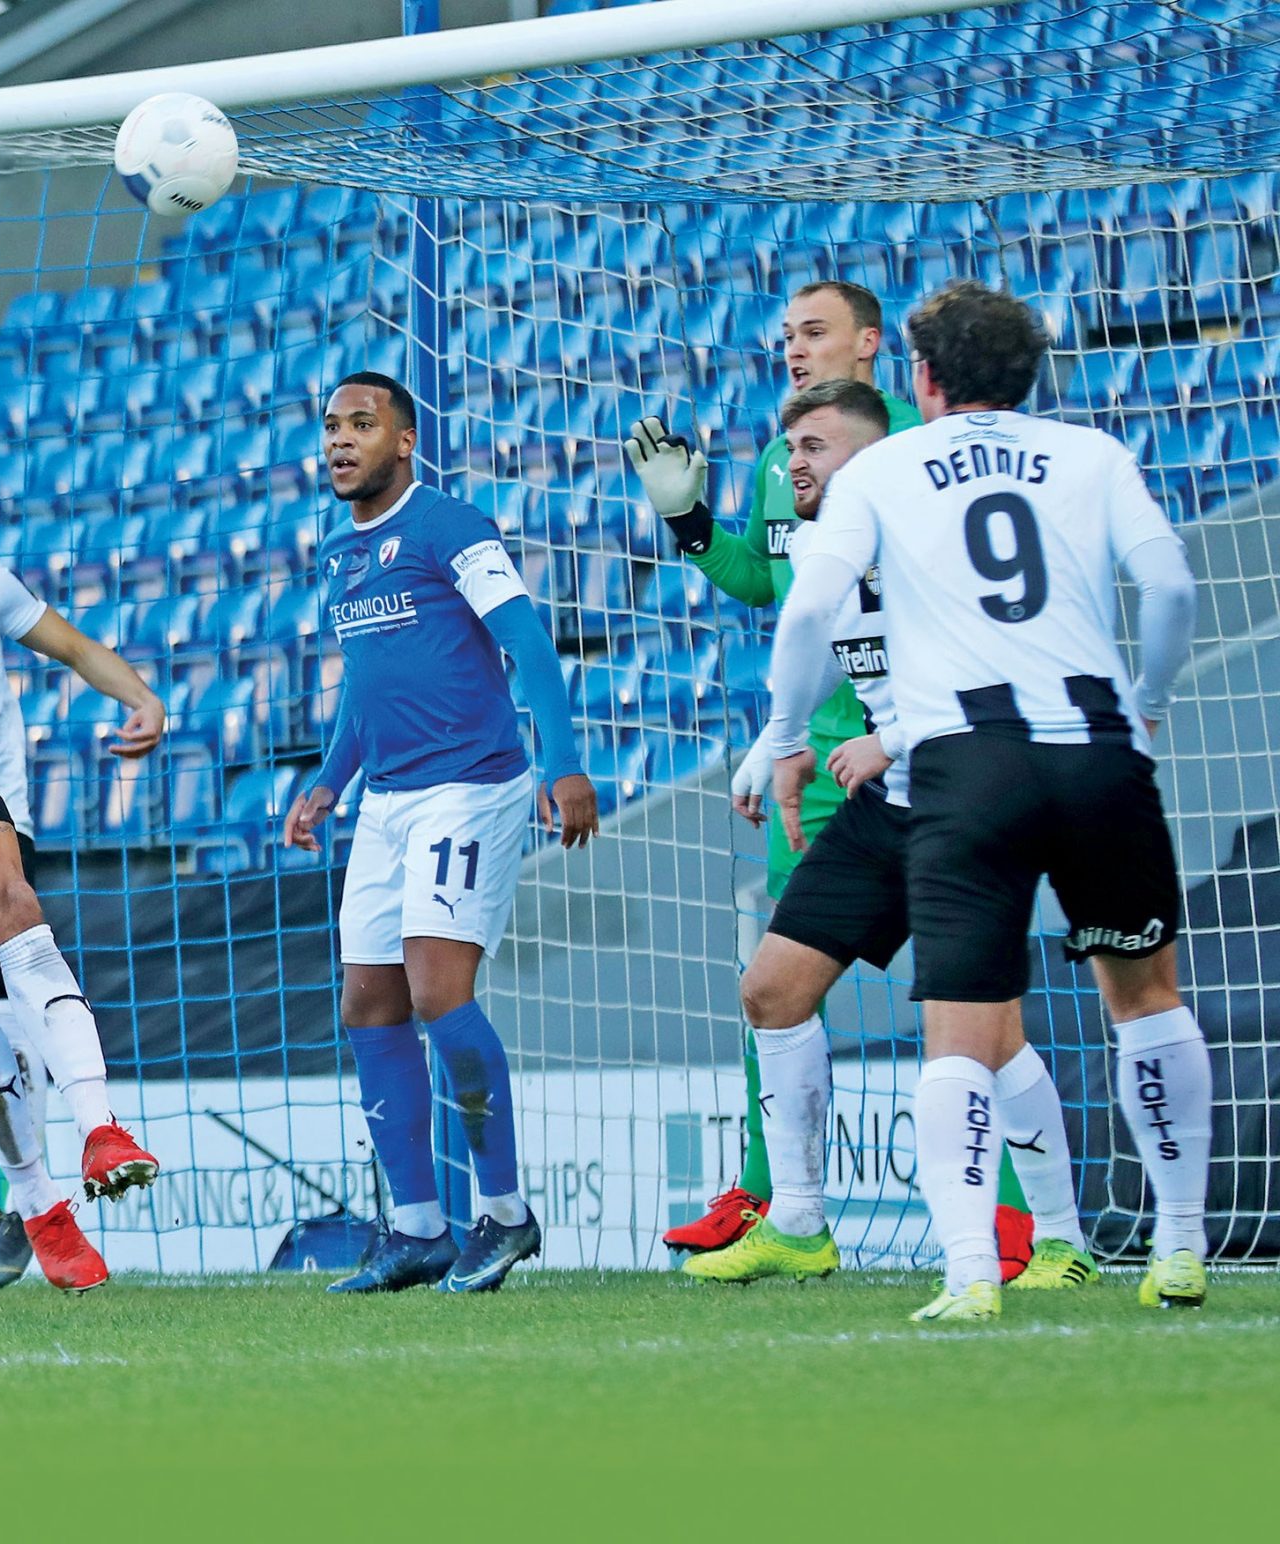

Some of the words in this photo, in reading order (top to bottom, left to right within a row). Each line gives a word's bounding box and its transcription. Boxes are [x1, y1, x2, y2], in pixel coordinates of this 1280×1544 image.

[169, 193, 203, 211] JAKO
[924, 444, 1051, 490] DENNIS
[768, 524, 795, 554] Life
[964, 491, 1048, 623] 9
[329, 592, 415, 624] TECHNIQUE
[836, 642, 888, 674] ifelin
[430, 837, 480, 890] 11
[1135, 1058, 1181, 1161] NOTTS
[963, 1090, 990, 1186] NOTTS
